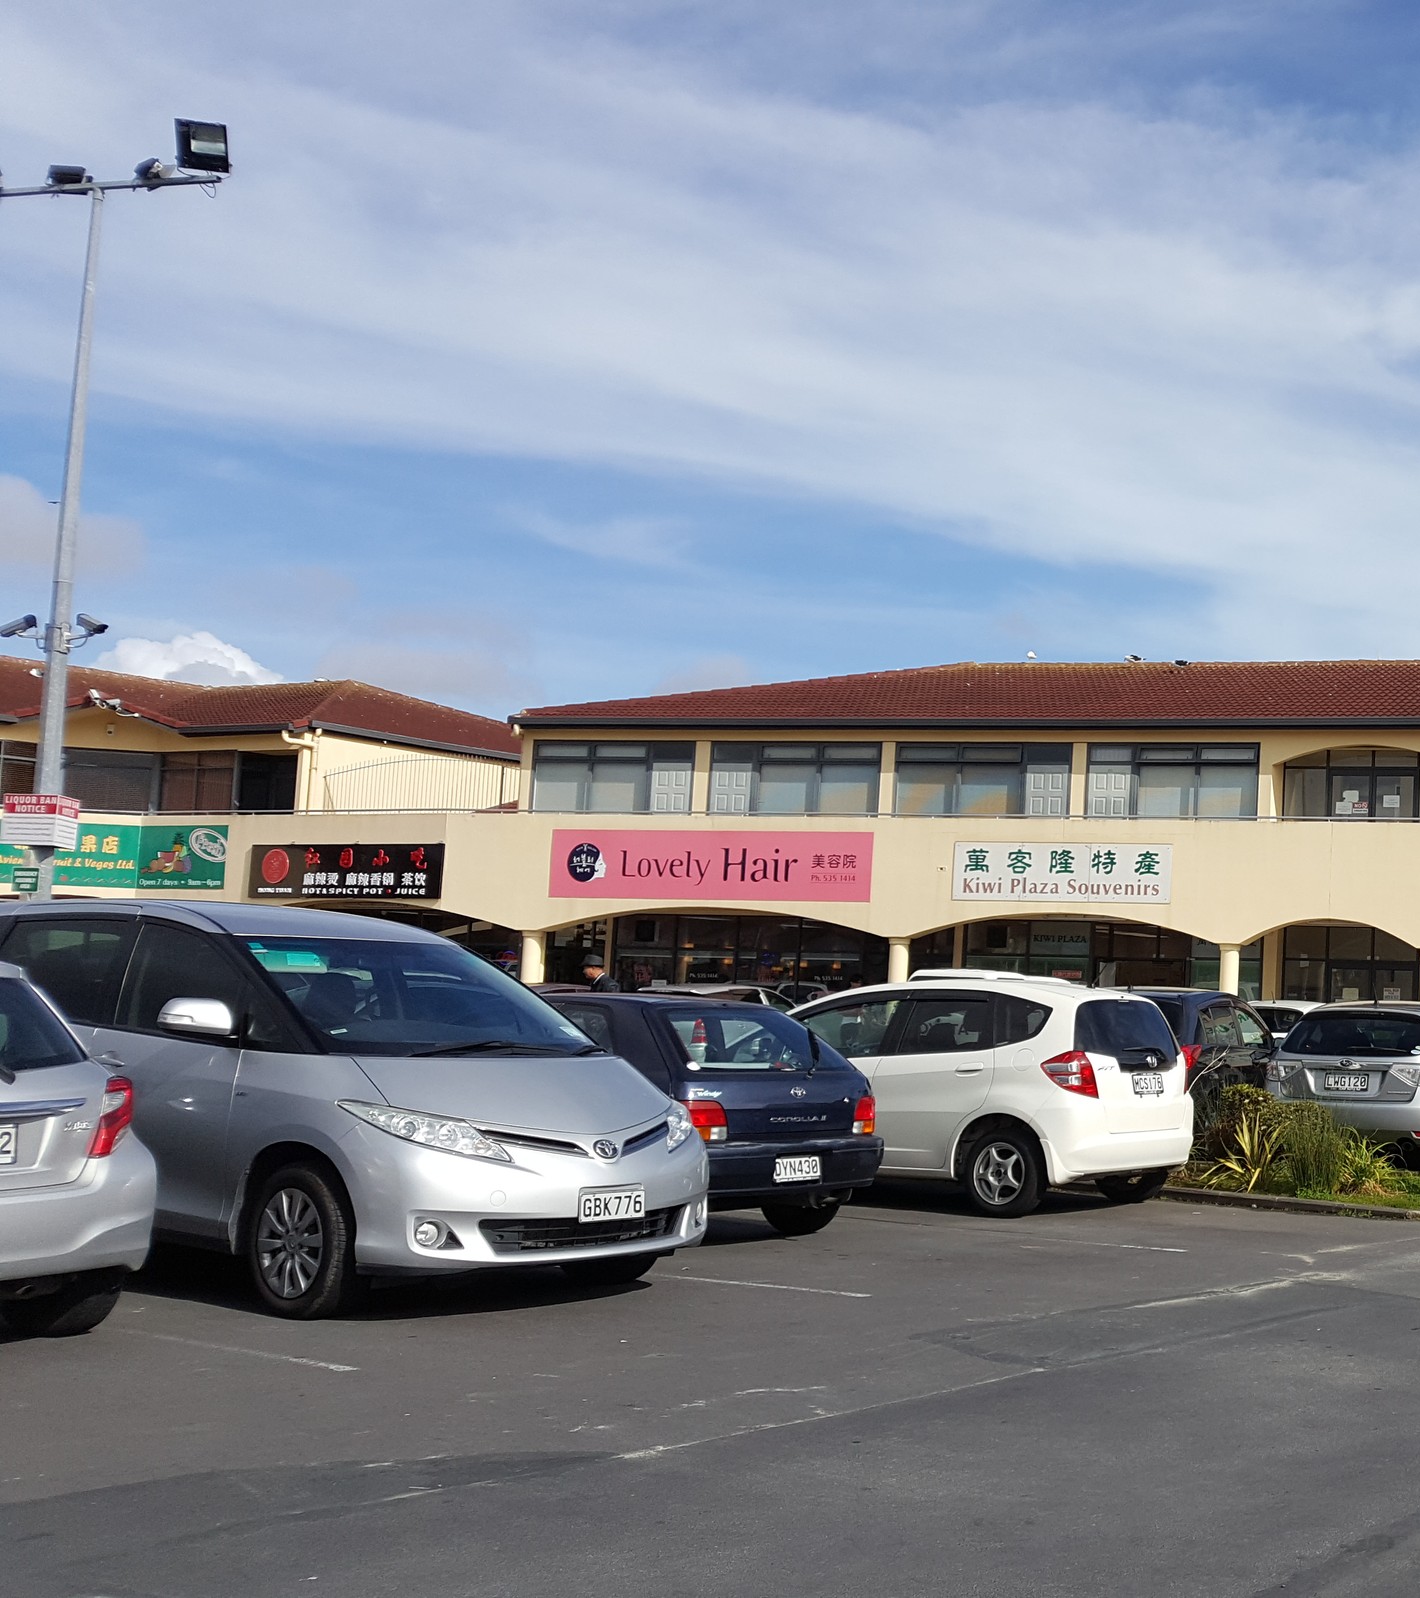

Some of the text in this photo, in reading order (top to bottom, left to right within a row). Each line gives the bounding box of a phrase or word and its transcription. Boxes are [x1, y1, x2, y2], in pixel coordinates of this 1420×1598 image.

[5, 796, 58, 804] LIQUOR BAN
[15, 804, 46, 813] NOTICE
[53, 857, 72, 867] ruit
[73, 858, 83, 867] &
[85, 858, 114, 871] Veges
[116, 860, 135, 869] Ltd.
[620, 847, 799, 886] Lovely Hair
[810, 854, 857, 869] 美容院
[963, 848, 1161, 876] 萬客隆特產
[139, 878, 156, 887] Open
[162, 878, 178, 886] days
[962, 877, 1161, 896] Kiwi Plaza Souvenirs
[362, 887, 383, 895] POT
[394, 888, 426, 896] JUICE
[1033, 934, 1087, 944] KIWI PLAZA
[1134, 1077, 1162, 1091] MCS176
[1326, 1075, 1367, 1090] LWG120
[775, 1159, 819, 1177] DYN430
[583, 1195, 643, 1217] GBK776
